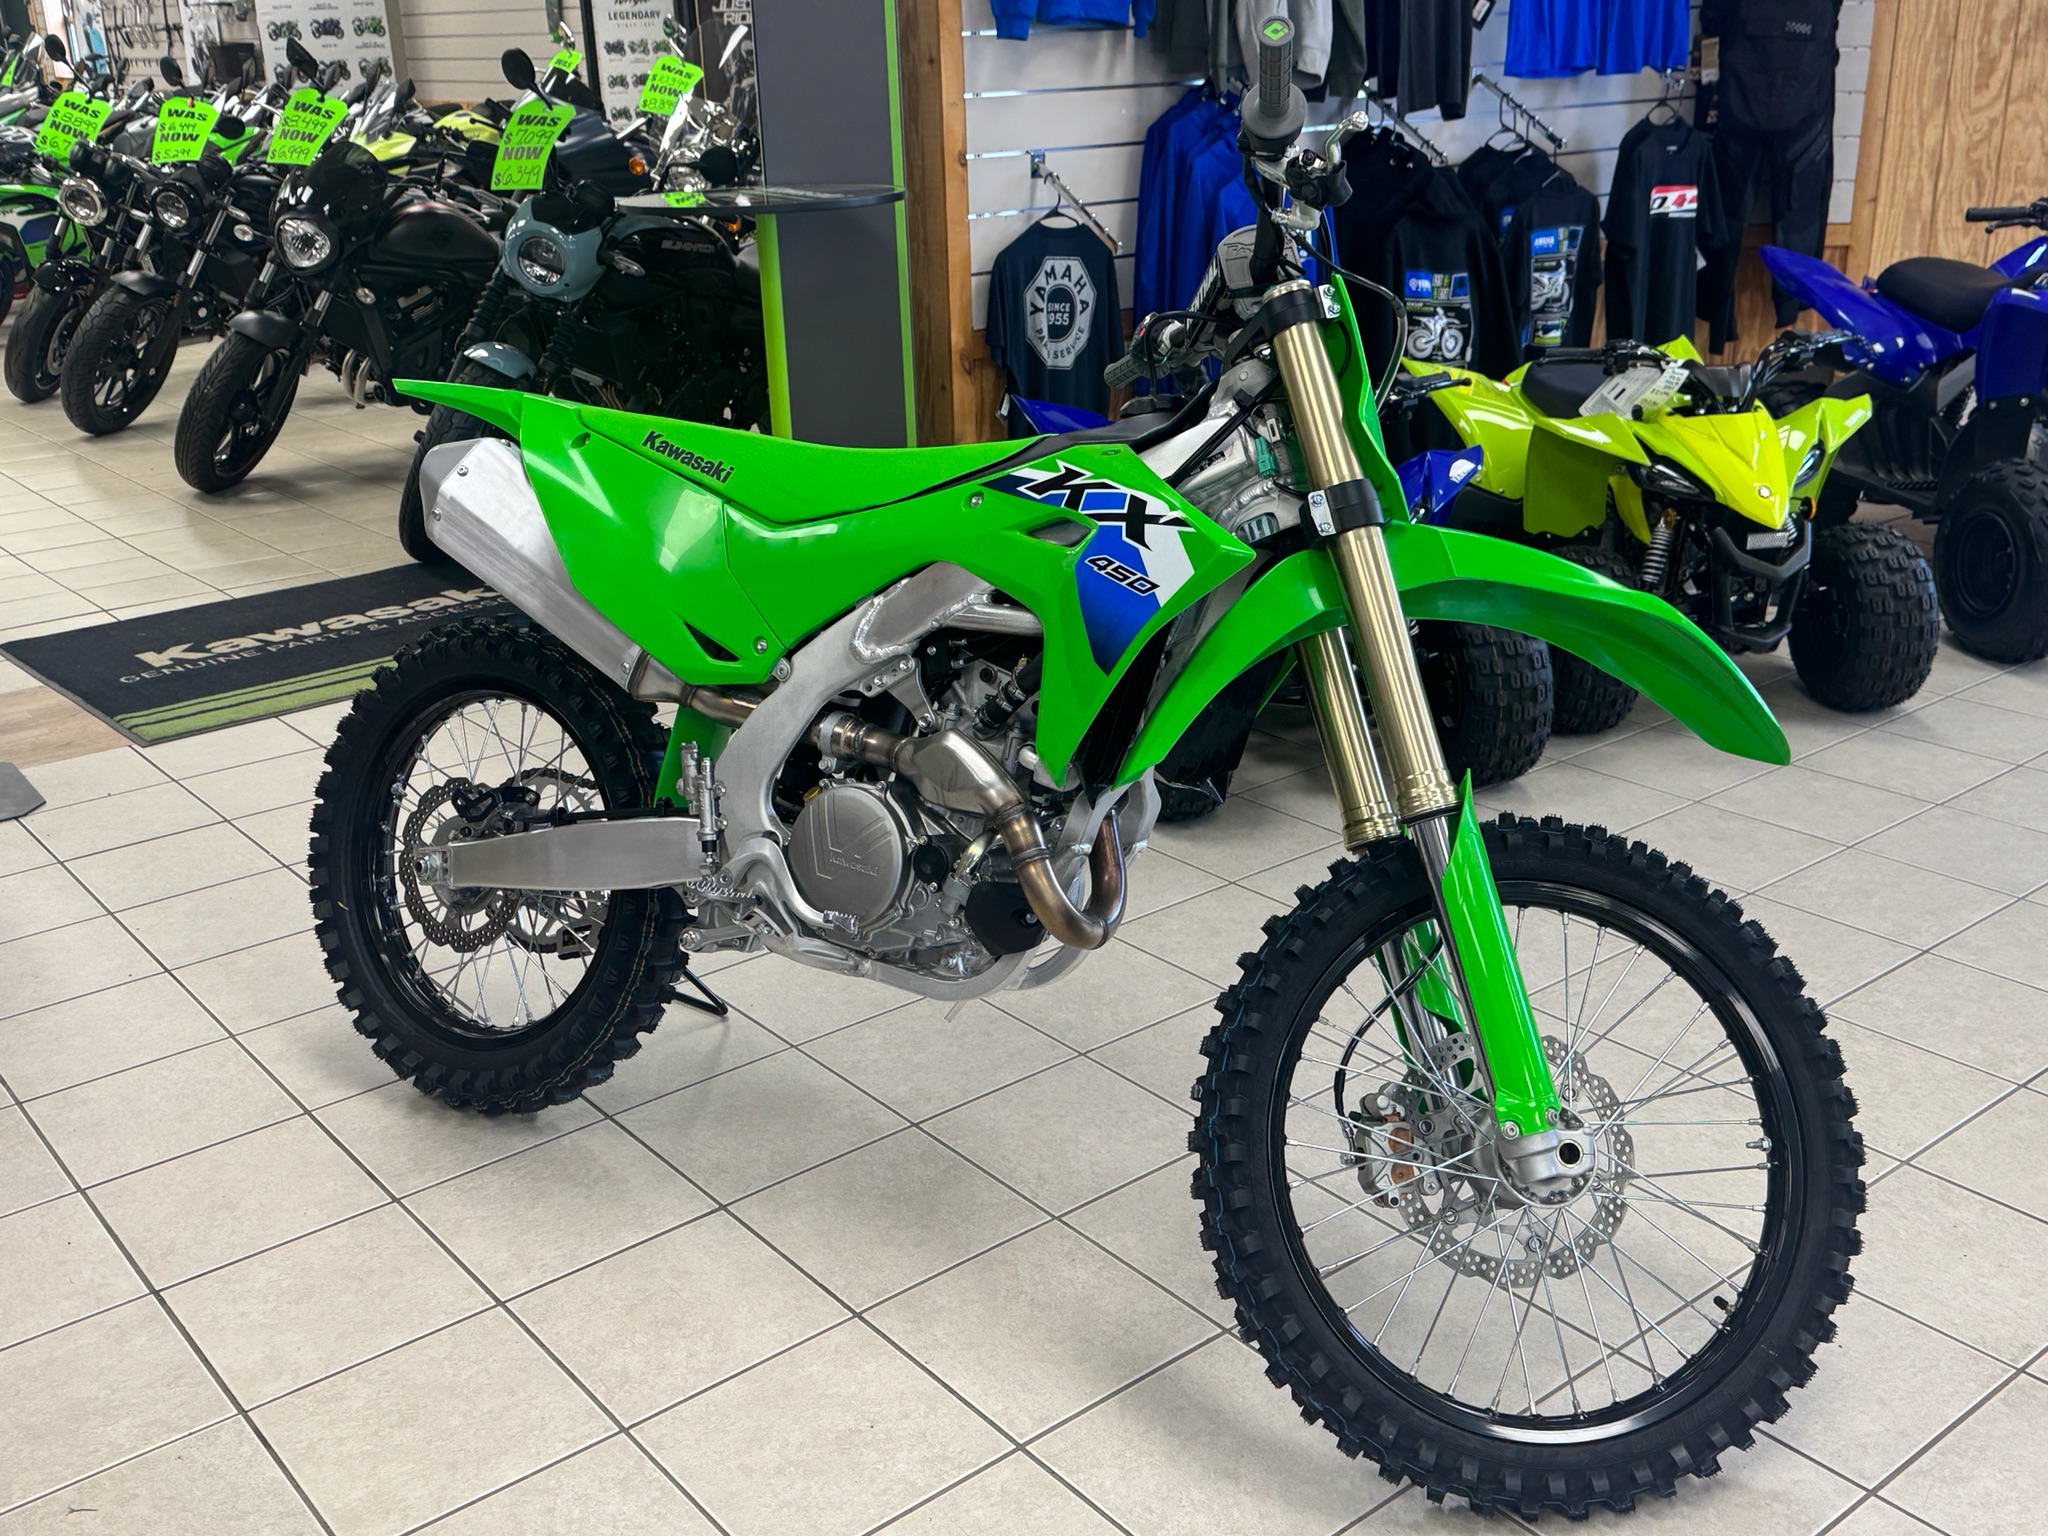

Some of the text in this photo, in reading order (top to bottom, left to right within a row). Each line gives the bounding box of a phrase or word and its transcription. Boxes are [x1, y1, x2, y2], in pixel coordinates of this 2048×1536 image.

[608, 10, 661, 21] LEGENDARY
[723, 12, 750, 26] RID
[661, 63, 693, 79] WAS
[649, 83, 682, 97] NOW
[63, 99, 101, 118] WAS
[167, 108, 208, 121] WAS
[293, 100, 336, 119] WAS
[517, 114, 561, 127] WAS
[49, 120, 90, 139] NOW
[160, 132, 200, 142] NOW
[279, 128, 319, 143] NOW
[502, 145, 544, 160] NOW
[1029, 264, 1089, 316] YAMAHA
[1047, 302, 1071, 312] SINCE
[1048, 312, 1070, 325] 955
[1053, 326, 1085, 359] SERVICE
[641, 430, 735, 484] Kawasaki
[997, 459, 1197, 552] KX
[1084, 555, 1160, 596] 450
[135, 588, 501, 668] Kawasak
[119, 648, 261, 684] GENUINE
[266, 629, 360, 653] PARTS
[368, 623, 389, 632] &
